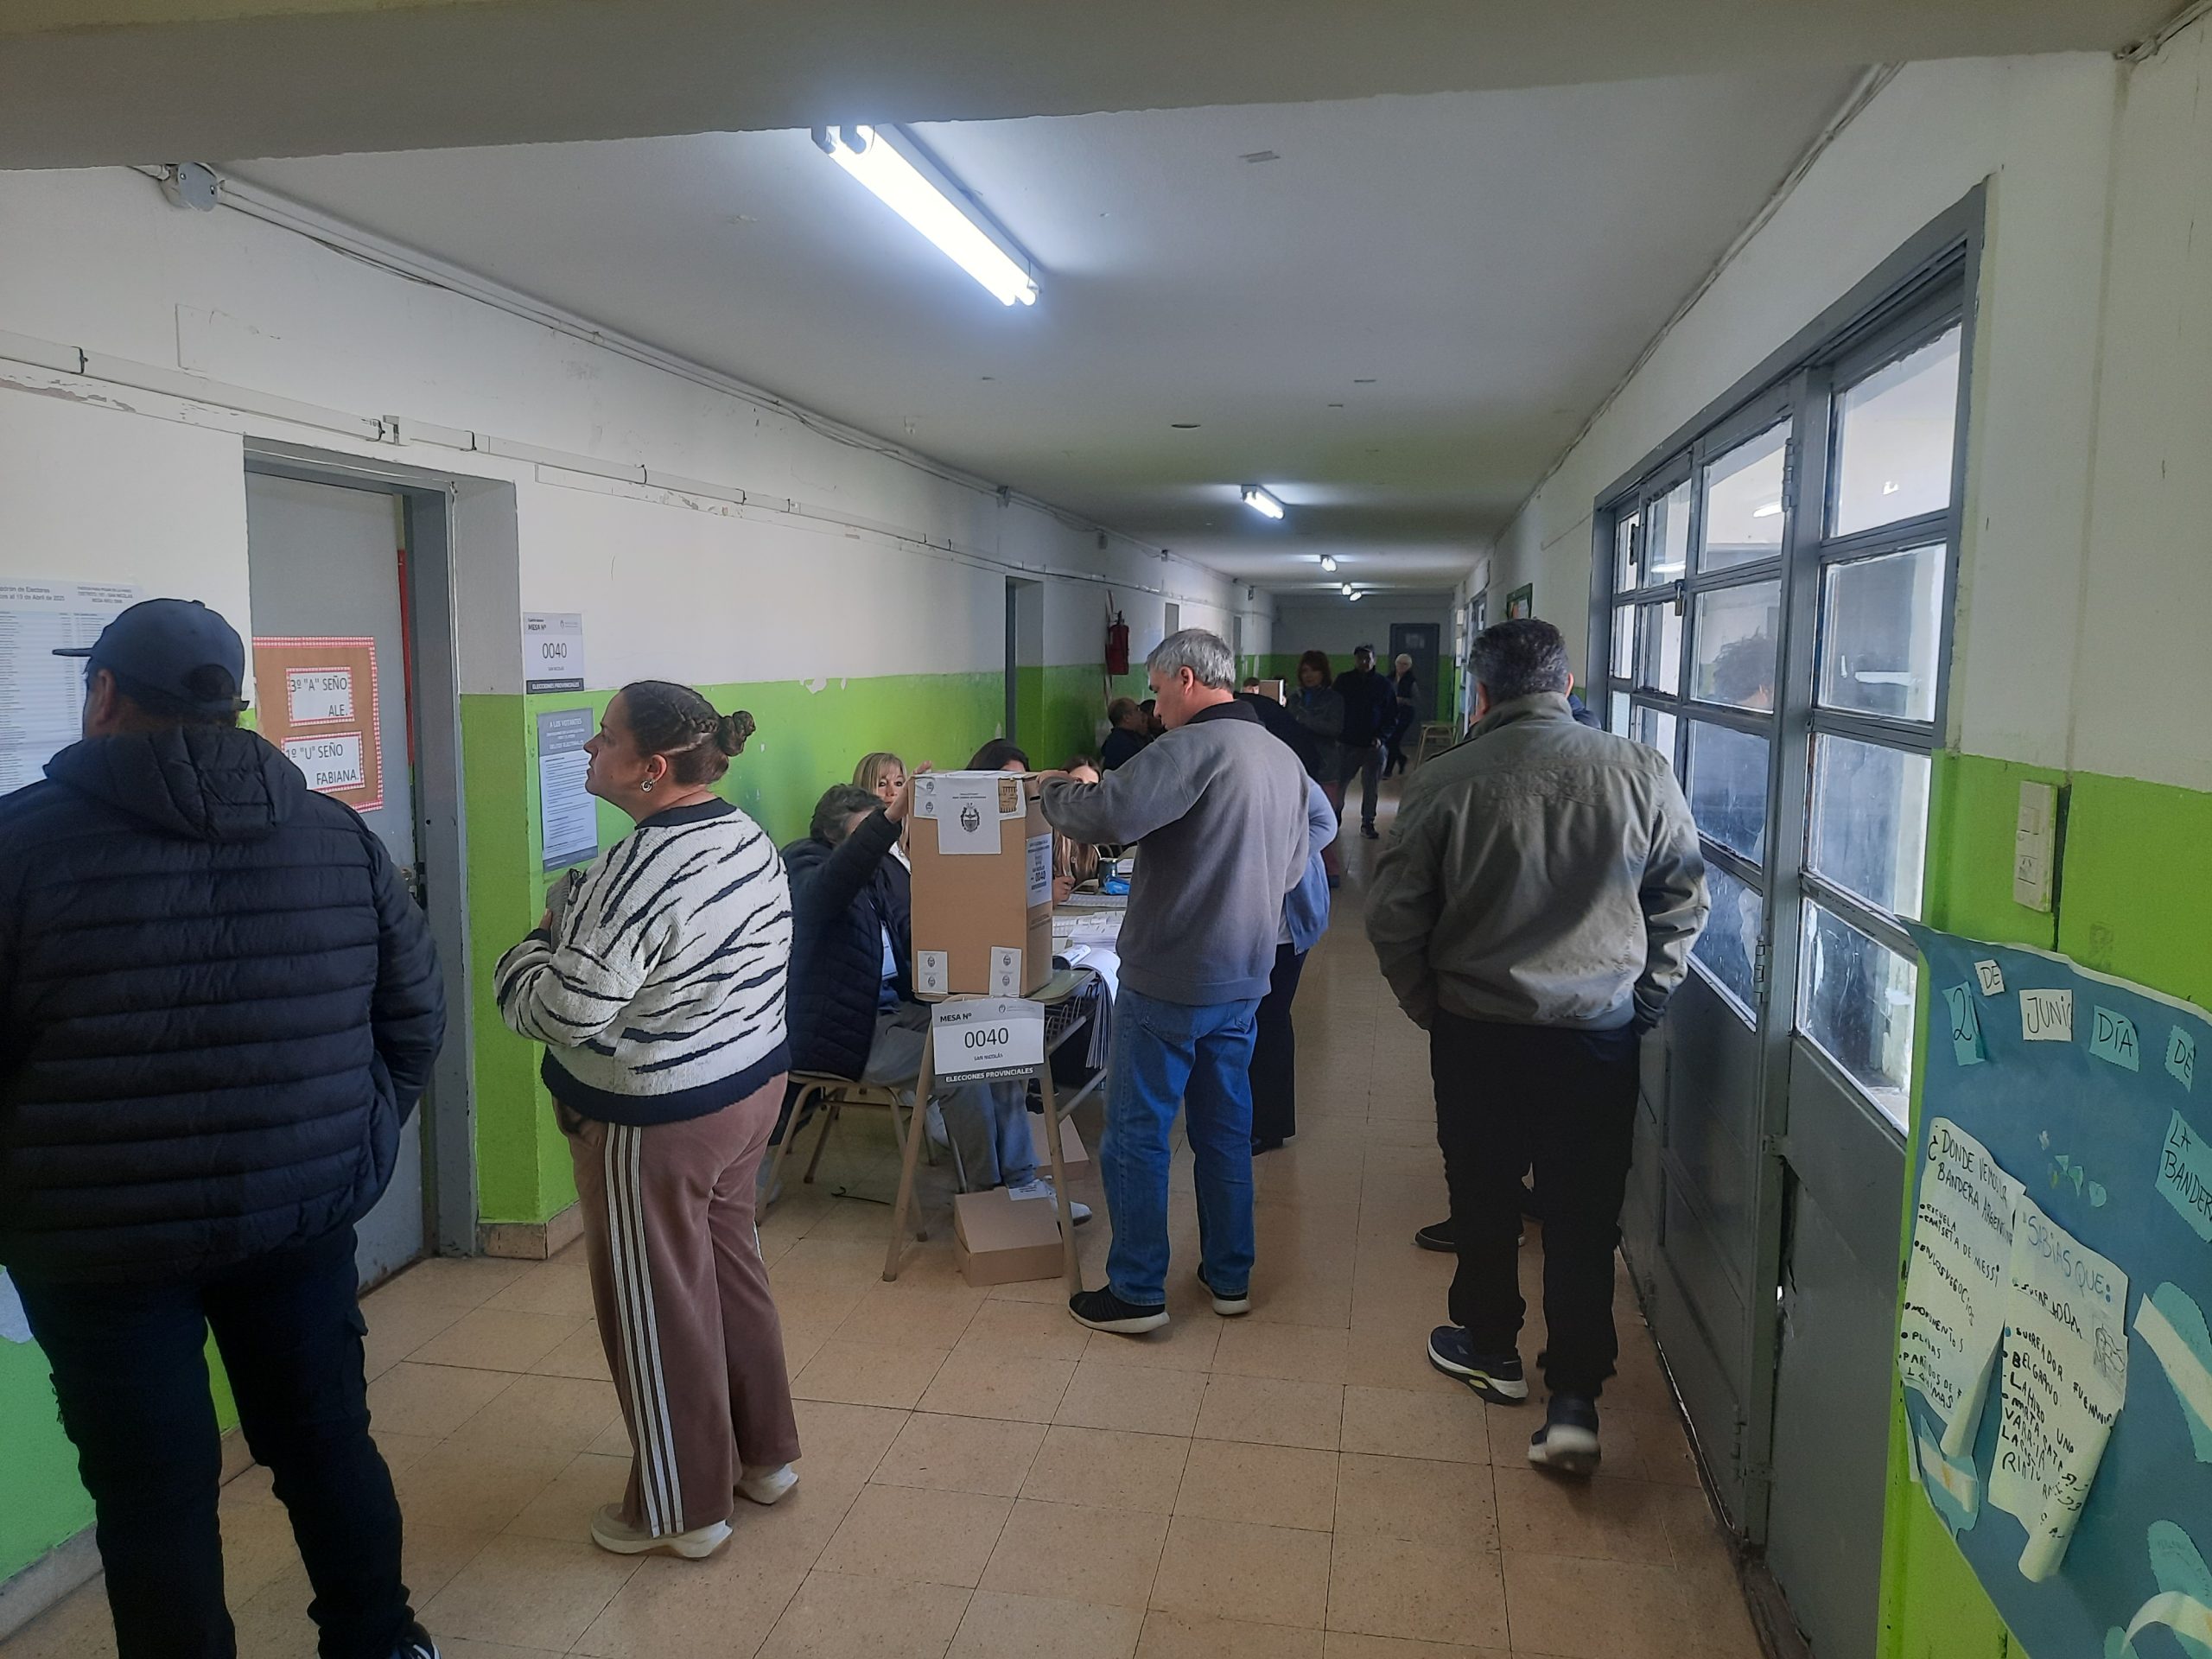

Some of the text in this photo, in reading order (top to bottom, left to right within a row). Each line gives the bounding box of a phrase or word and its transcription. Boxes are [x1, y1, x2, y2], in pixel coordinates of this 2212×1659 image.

[542, 643, 567, 658] 0040
[303, 678, 320, 692] "A"
[322, 676, 347, 690] SEÑO
[328, 704, 347, 717] ALE.
[318, 742, 343, 759] SEÑO
[316, 768, 359, 785] FABIANA.
[940, 1012, 972, 1023] MESA Nº
[1980, 966, 2000, 989] DE
[2027, 995, 2071, 1033] JUNI
[2098, 1013, 2133, 1058] DÍA
[2174, 1039, 2192, 1078] DE
[964, 1027, 1009, 1048] 0040
[946, 1067, 1033, 1083] ELECCIONES PROVINCIALES
[2171, 1120, 2191, 1152] LA
[1937, 1162, 1979, 1210] BANDERA
[2164, 1150, 2212, 1222] BANDER
[1962, 1244, 1972, 1258] DE
[1944, 1379, 1953, 1392] DE
